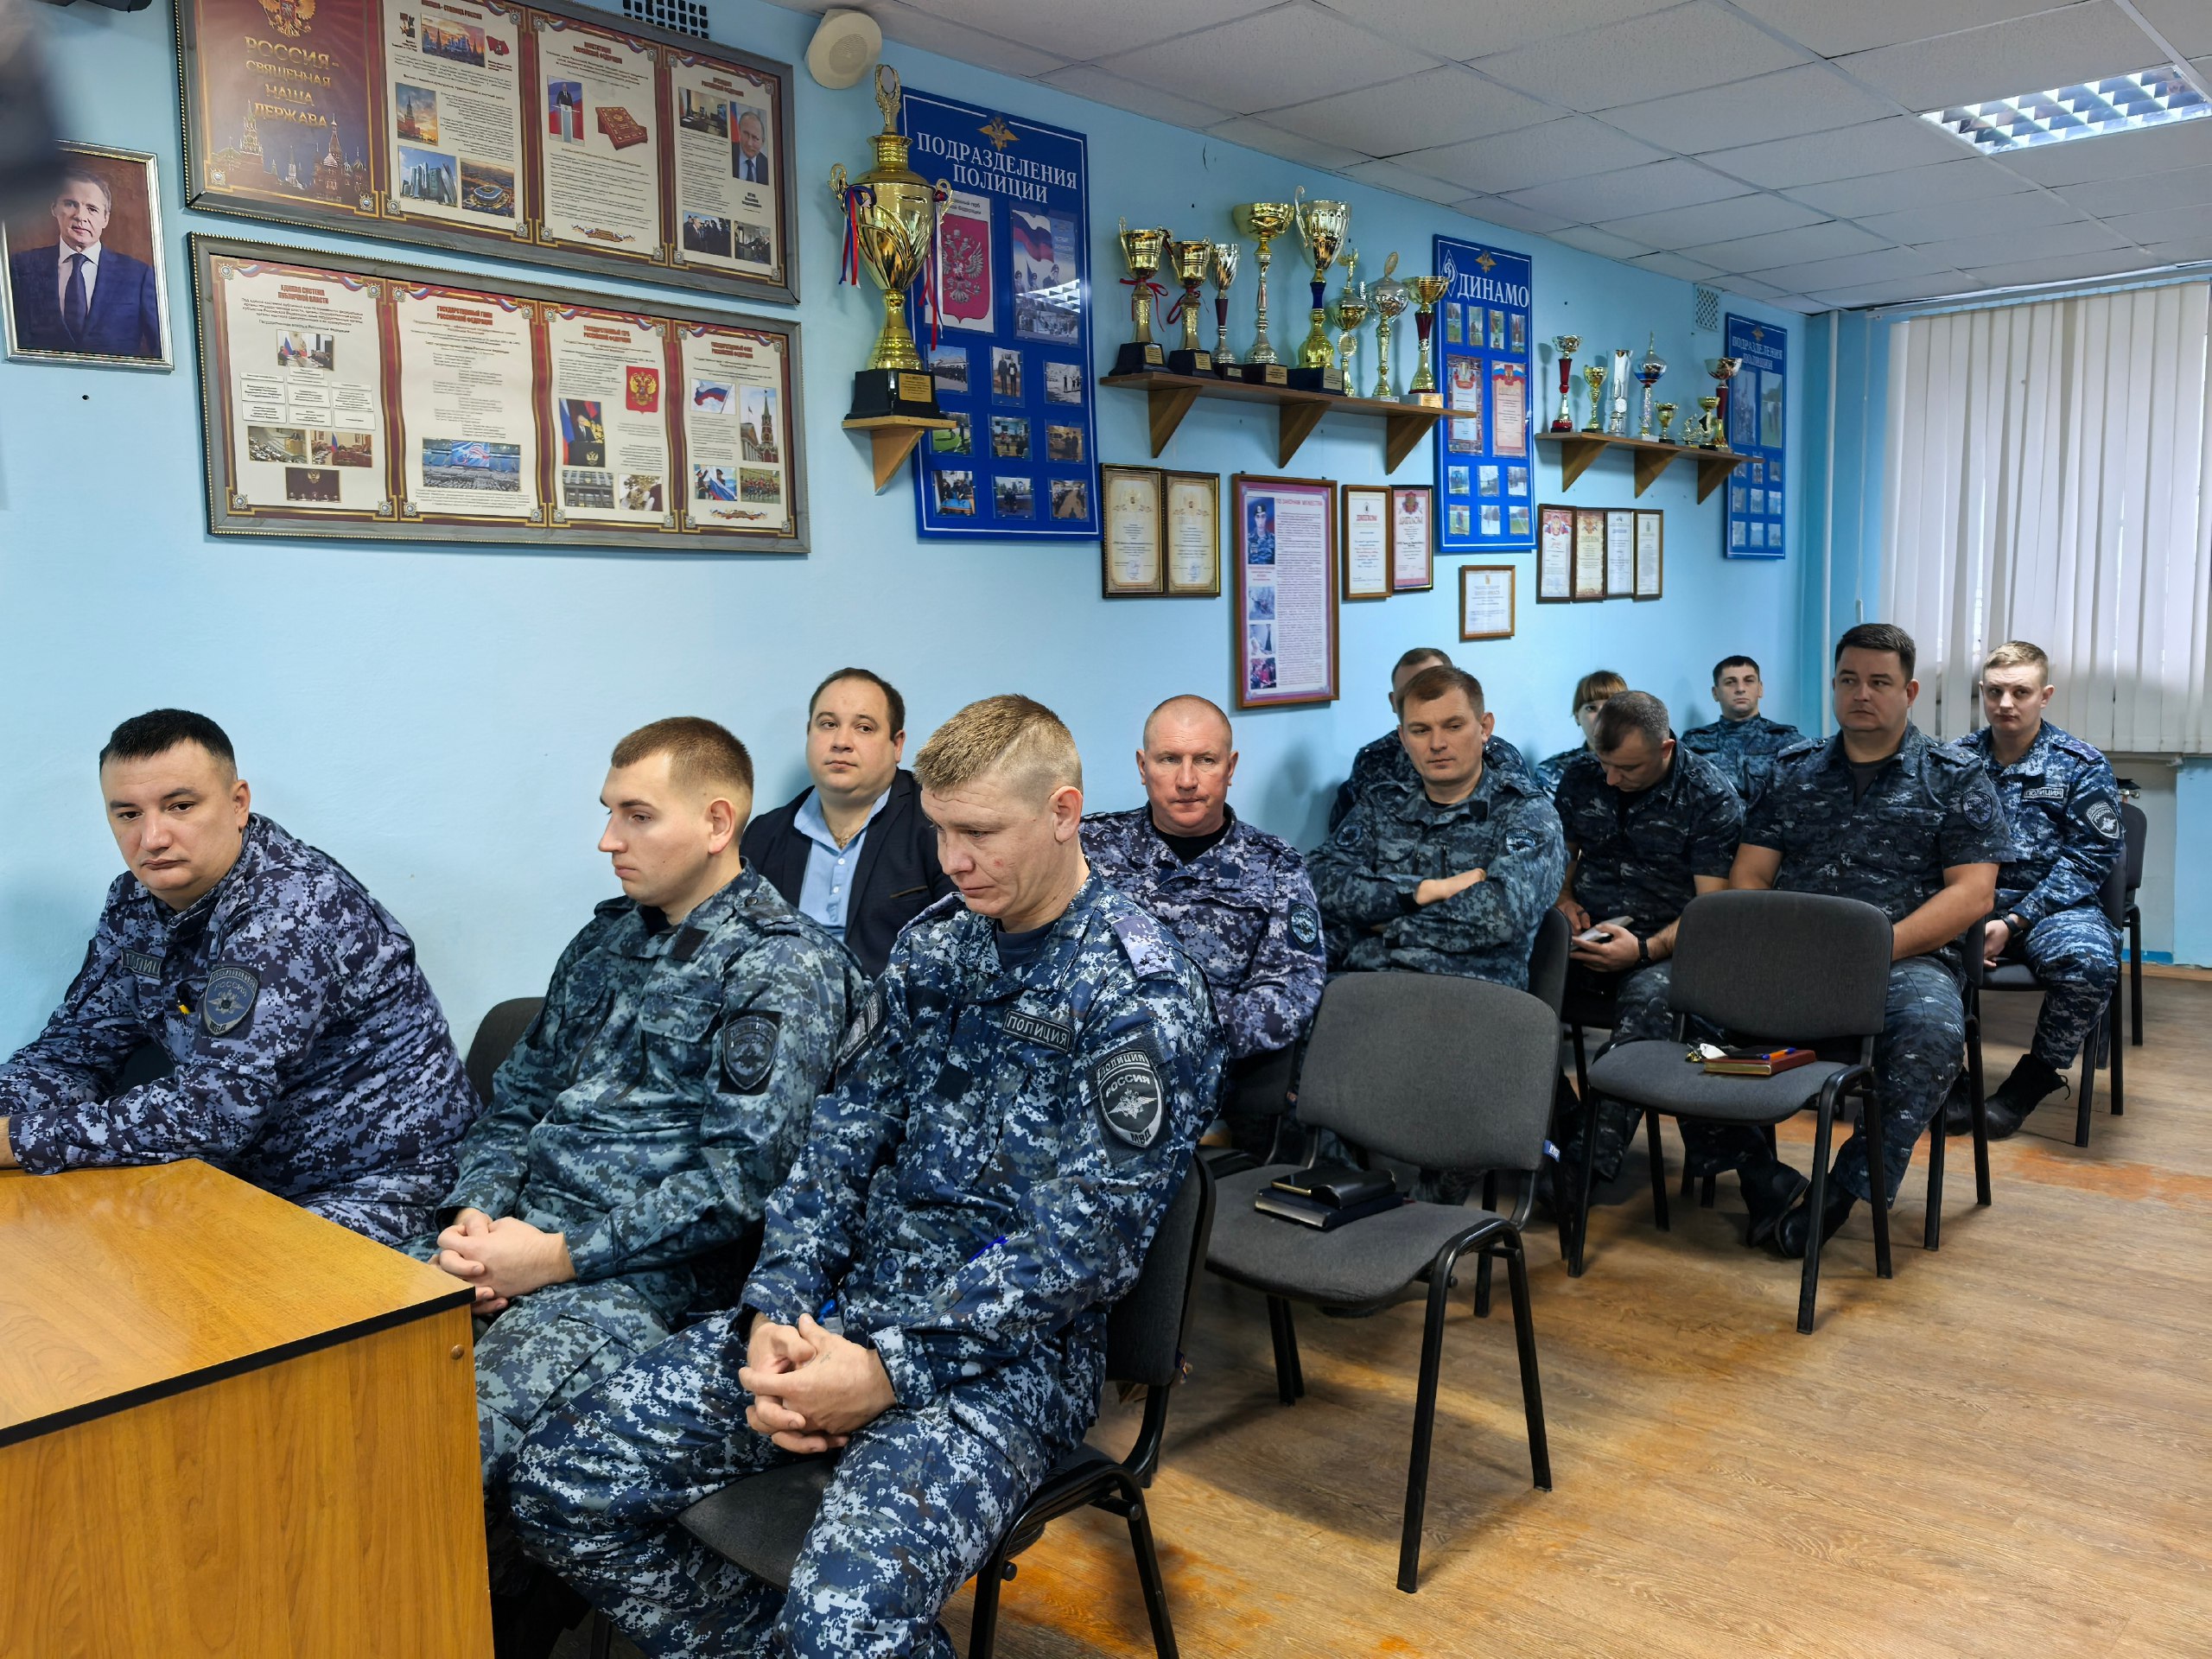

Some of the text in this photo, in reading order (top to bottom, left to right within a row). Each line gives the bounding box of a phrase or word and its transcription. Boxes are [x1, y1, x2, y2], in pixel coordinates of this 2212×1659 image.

[245, 60, 332, 87] СВЯЩЕННАЯ
[264, 83, 315, 106] НАША
[254, 102, 328, 127] ДЕРЖАВА
[917, 131, 1078, 189] ПОДРАЗДЕЛЕНИЯ
[953, 163, 1048, 204] ПОЛИЦИИ
[1457, 272, 1529, 308] ДИНАМО
[213, 968, 257, 988] ПОЛИЦИЯ
[214, 981, 247, 998] РОССИЯ
[1006, 1015, 1068, 1047] ПОЛИЦИЯ
[1099, 1052, 1147, 1077] ПОЛИЦИЯ
[1106, 1074, 1151, 1098] РОССИЯ
[1130, 1128, 1152, 1145] МВД
